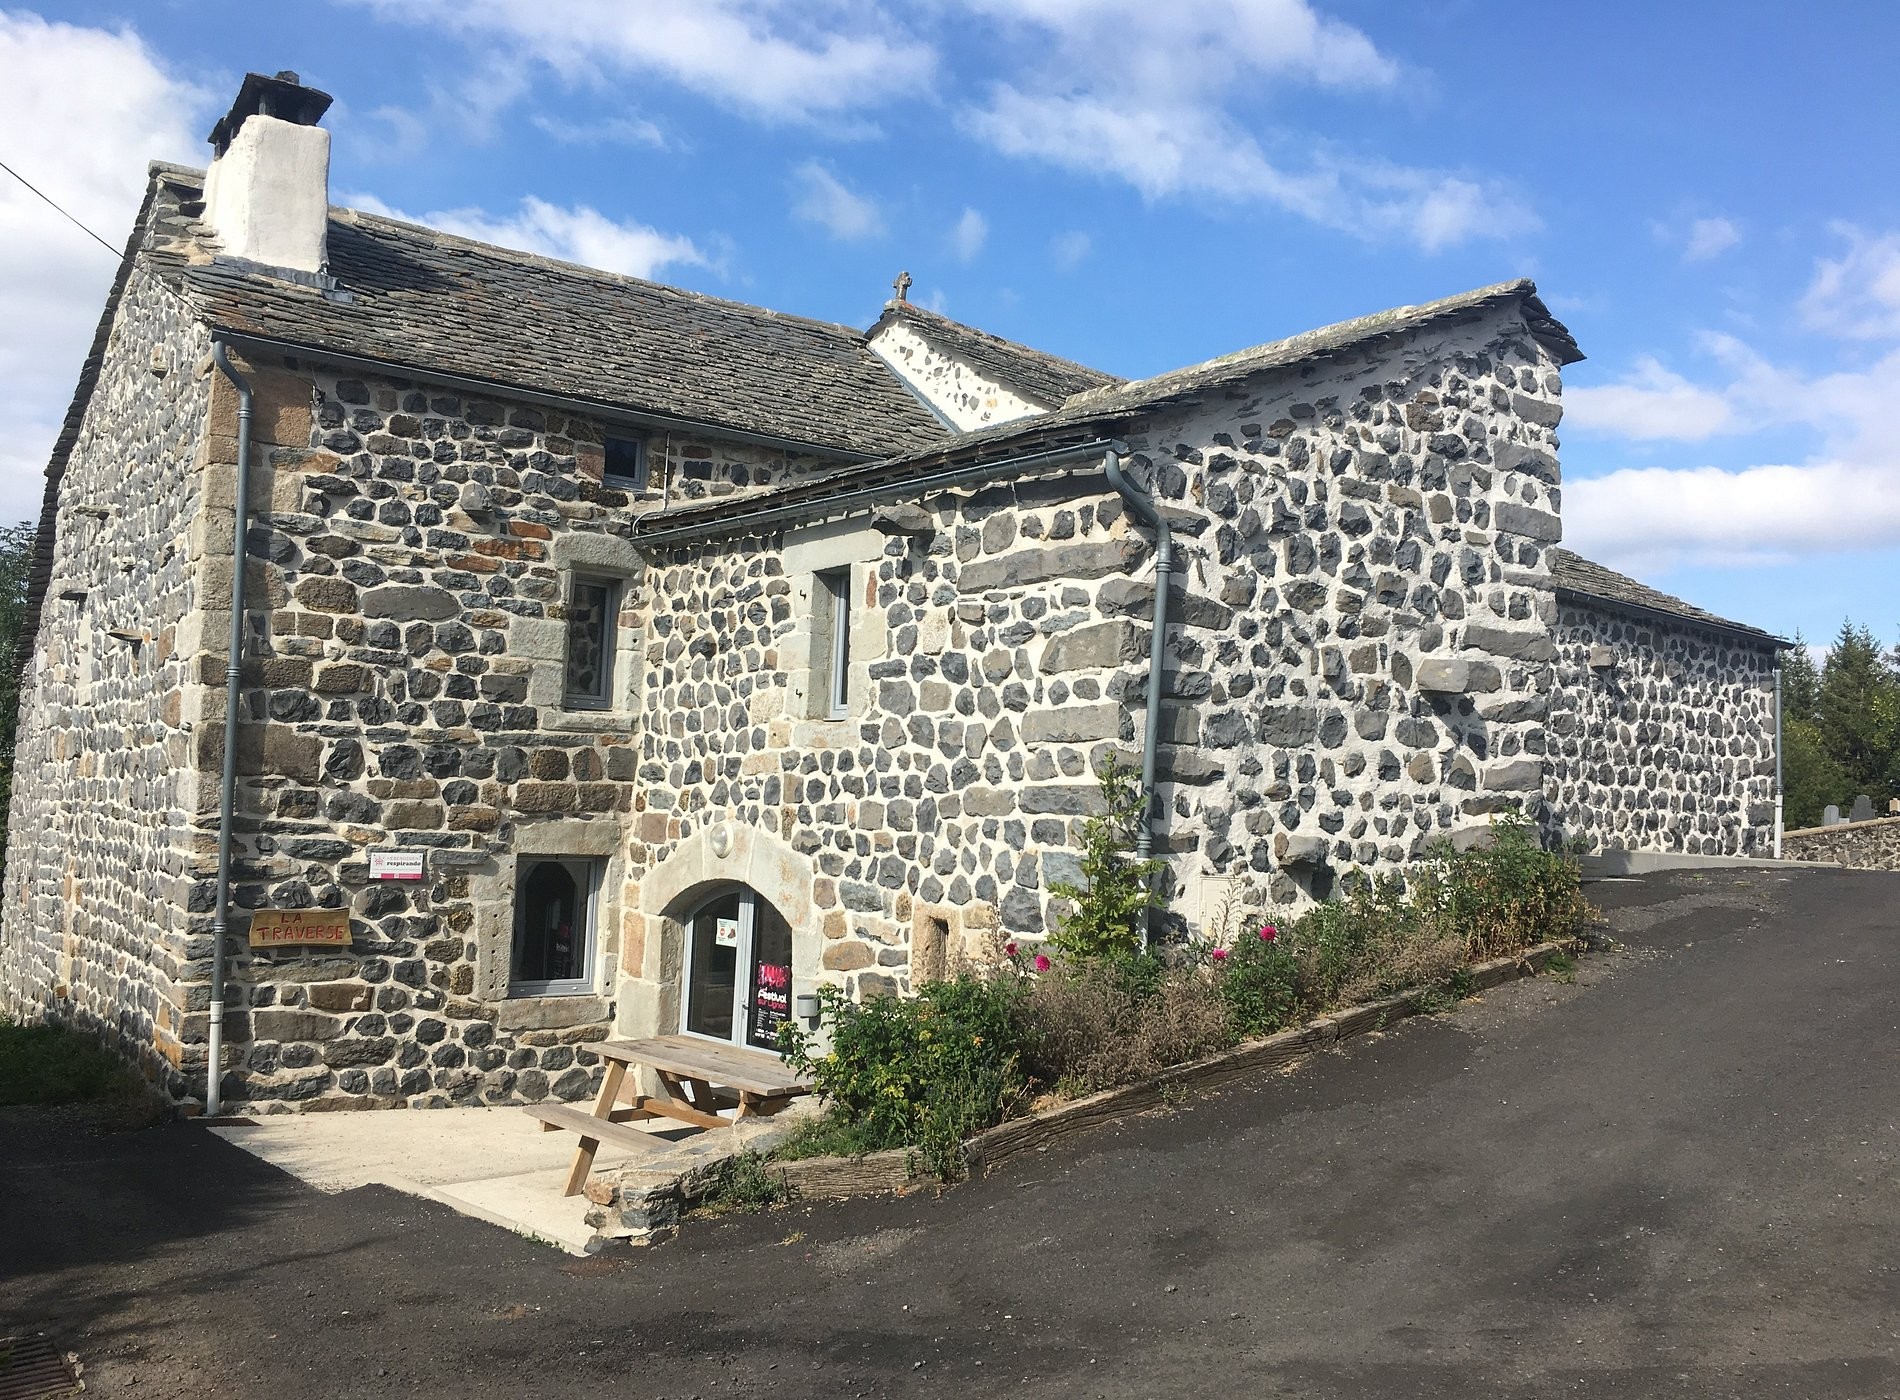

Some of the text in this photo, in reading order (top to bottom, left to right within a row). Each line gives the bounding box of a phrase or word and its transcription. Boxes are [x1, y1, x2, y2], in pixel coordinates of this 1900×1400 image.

[281, 913, 303, 923] LA
[257, 926, 344, 940] TRAVERSE
[758, 988, 787, 1003] Festival
